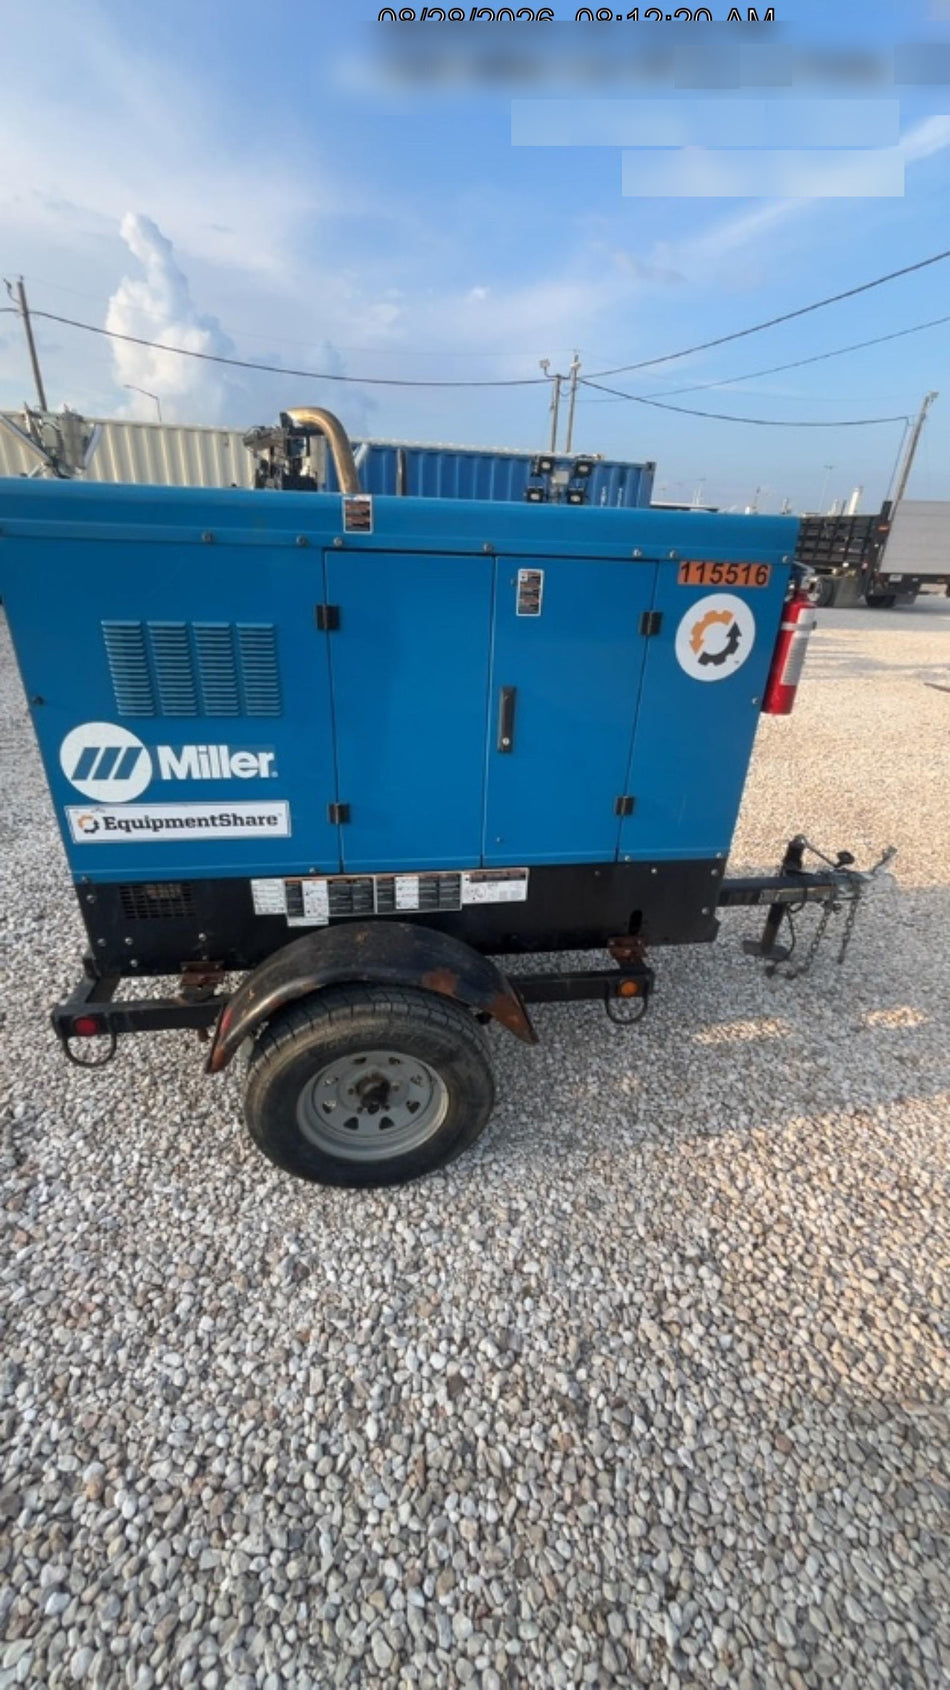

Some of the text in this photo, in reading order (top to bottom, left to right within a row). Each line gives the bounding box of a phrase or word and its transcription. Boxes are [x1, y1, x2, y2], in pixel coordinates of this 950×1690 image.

[680, 561, 769, 586] 115516
[156, 744, 275, 780] Miller
[103, 812, 280, 834] EquipmentShare
